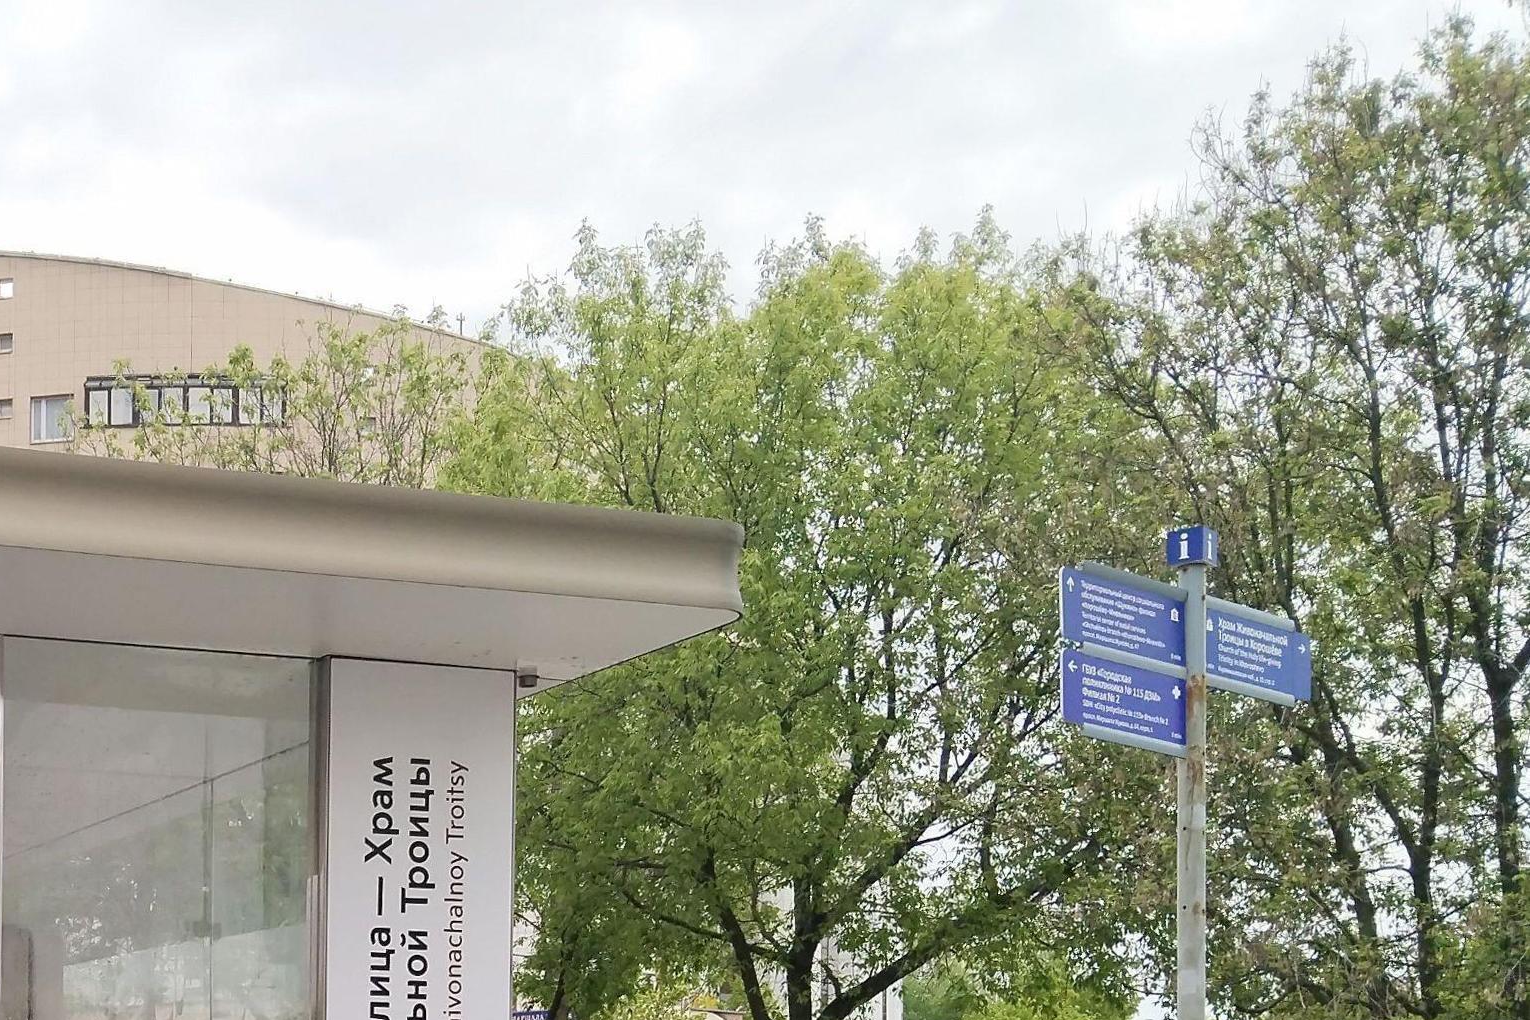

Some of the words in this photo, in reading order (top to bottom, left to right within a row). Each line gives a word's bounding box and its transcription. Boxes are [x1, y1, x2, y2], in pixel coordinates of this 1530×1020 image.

[365, 757, 400, 865] Храм
[401, 757, 436, 914] Троицы
[444, 760, 469, 845] Troitsy
